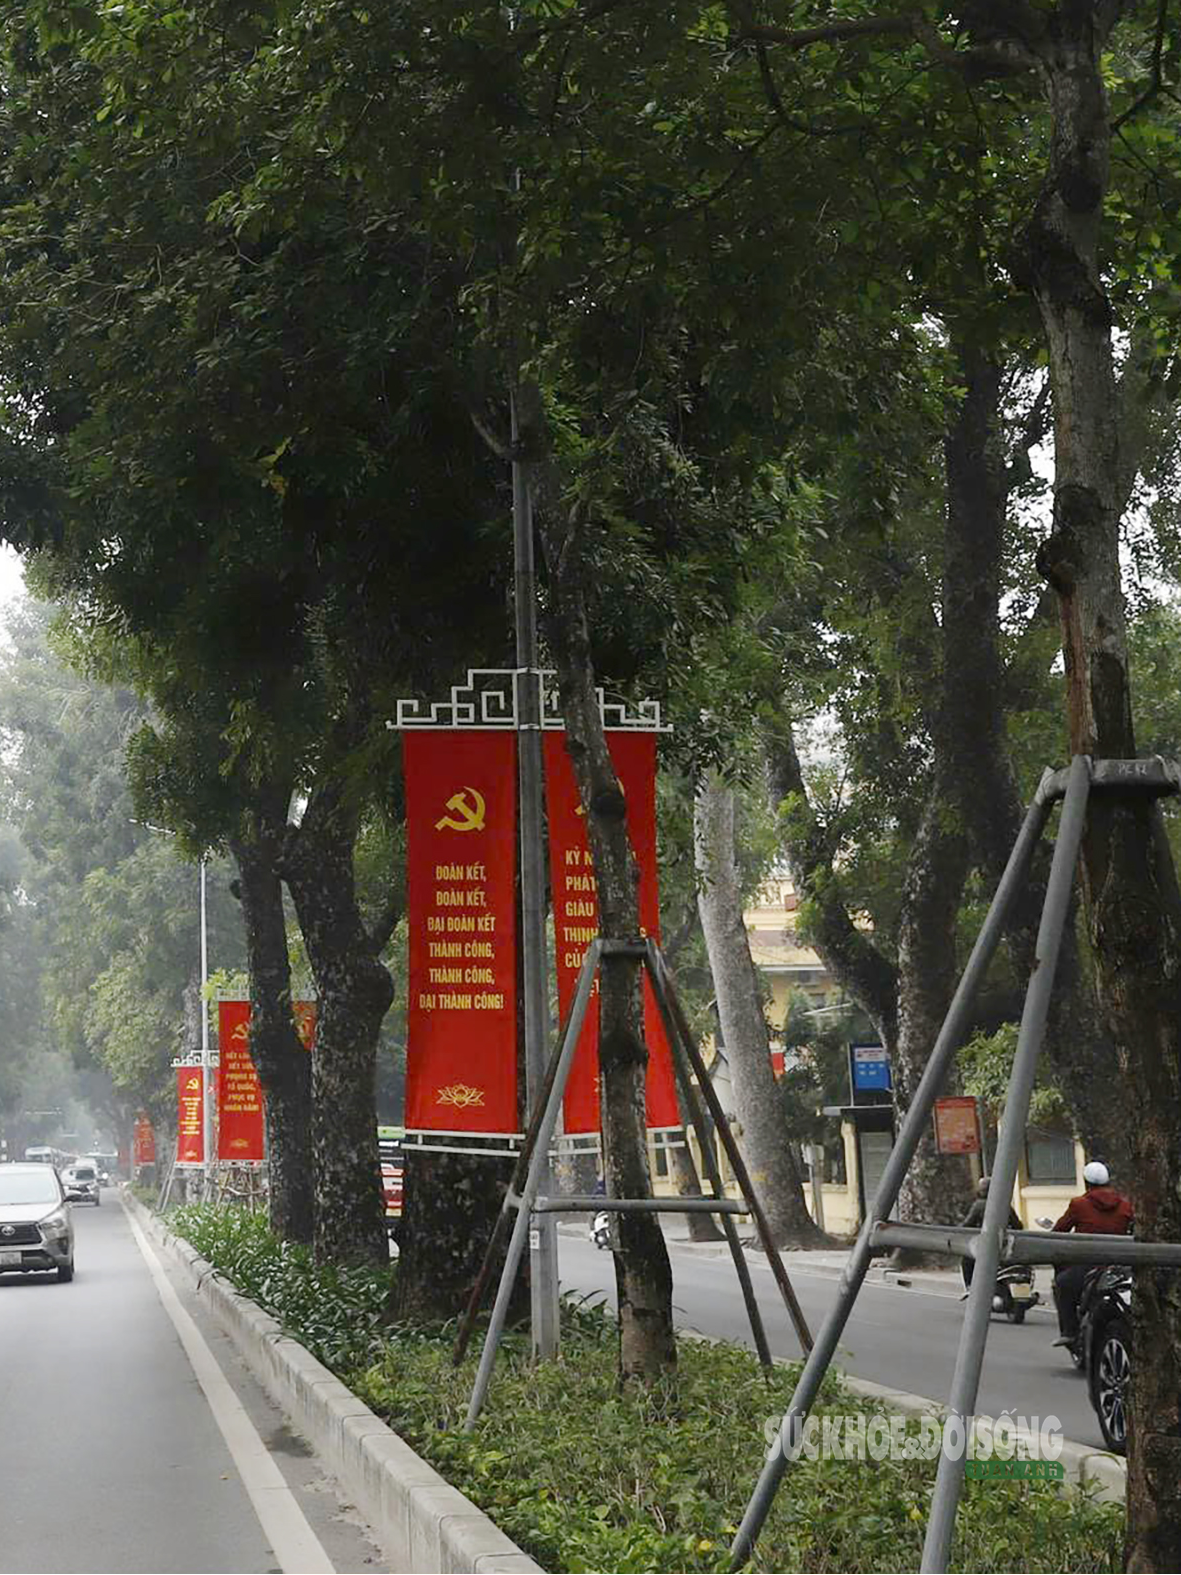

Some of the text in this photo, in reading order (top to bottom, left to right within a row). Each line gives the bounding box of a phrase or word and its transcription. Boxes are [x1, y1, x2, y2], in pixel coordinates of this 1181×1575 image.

[565, 845, 580, 866] KỶ
[436, 861, 487, 882] ĐOÀN KẾT,
[436, 886, 487, 907] ĐOÀN KẾT,
[565, 899, 594, 917] GIÀU
[427, 912, 496, 935] ĐẠI ĐOÀN KẾT
[429, 938, 495, 959] THÀNH CÔNG,
[429, 964, 495, 985] THÀNH CÔNG,
[419, 990, 504, 1013] ĐẠI THÀNH CÔNG!
